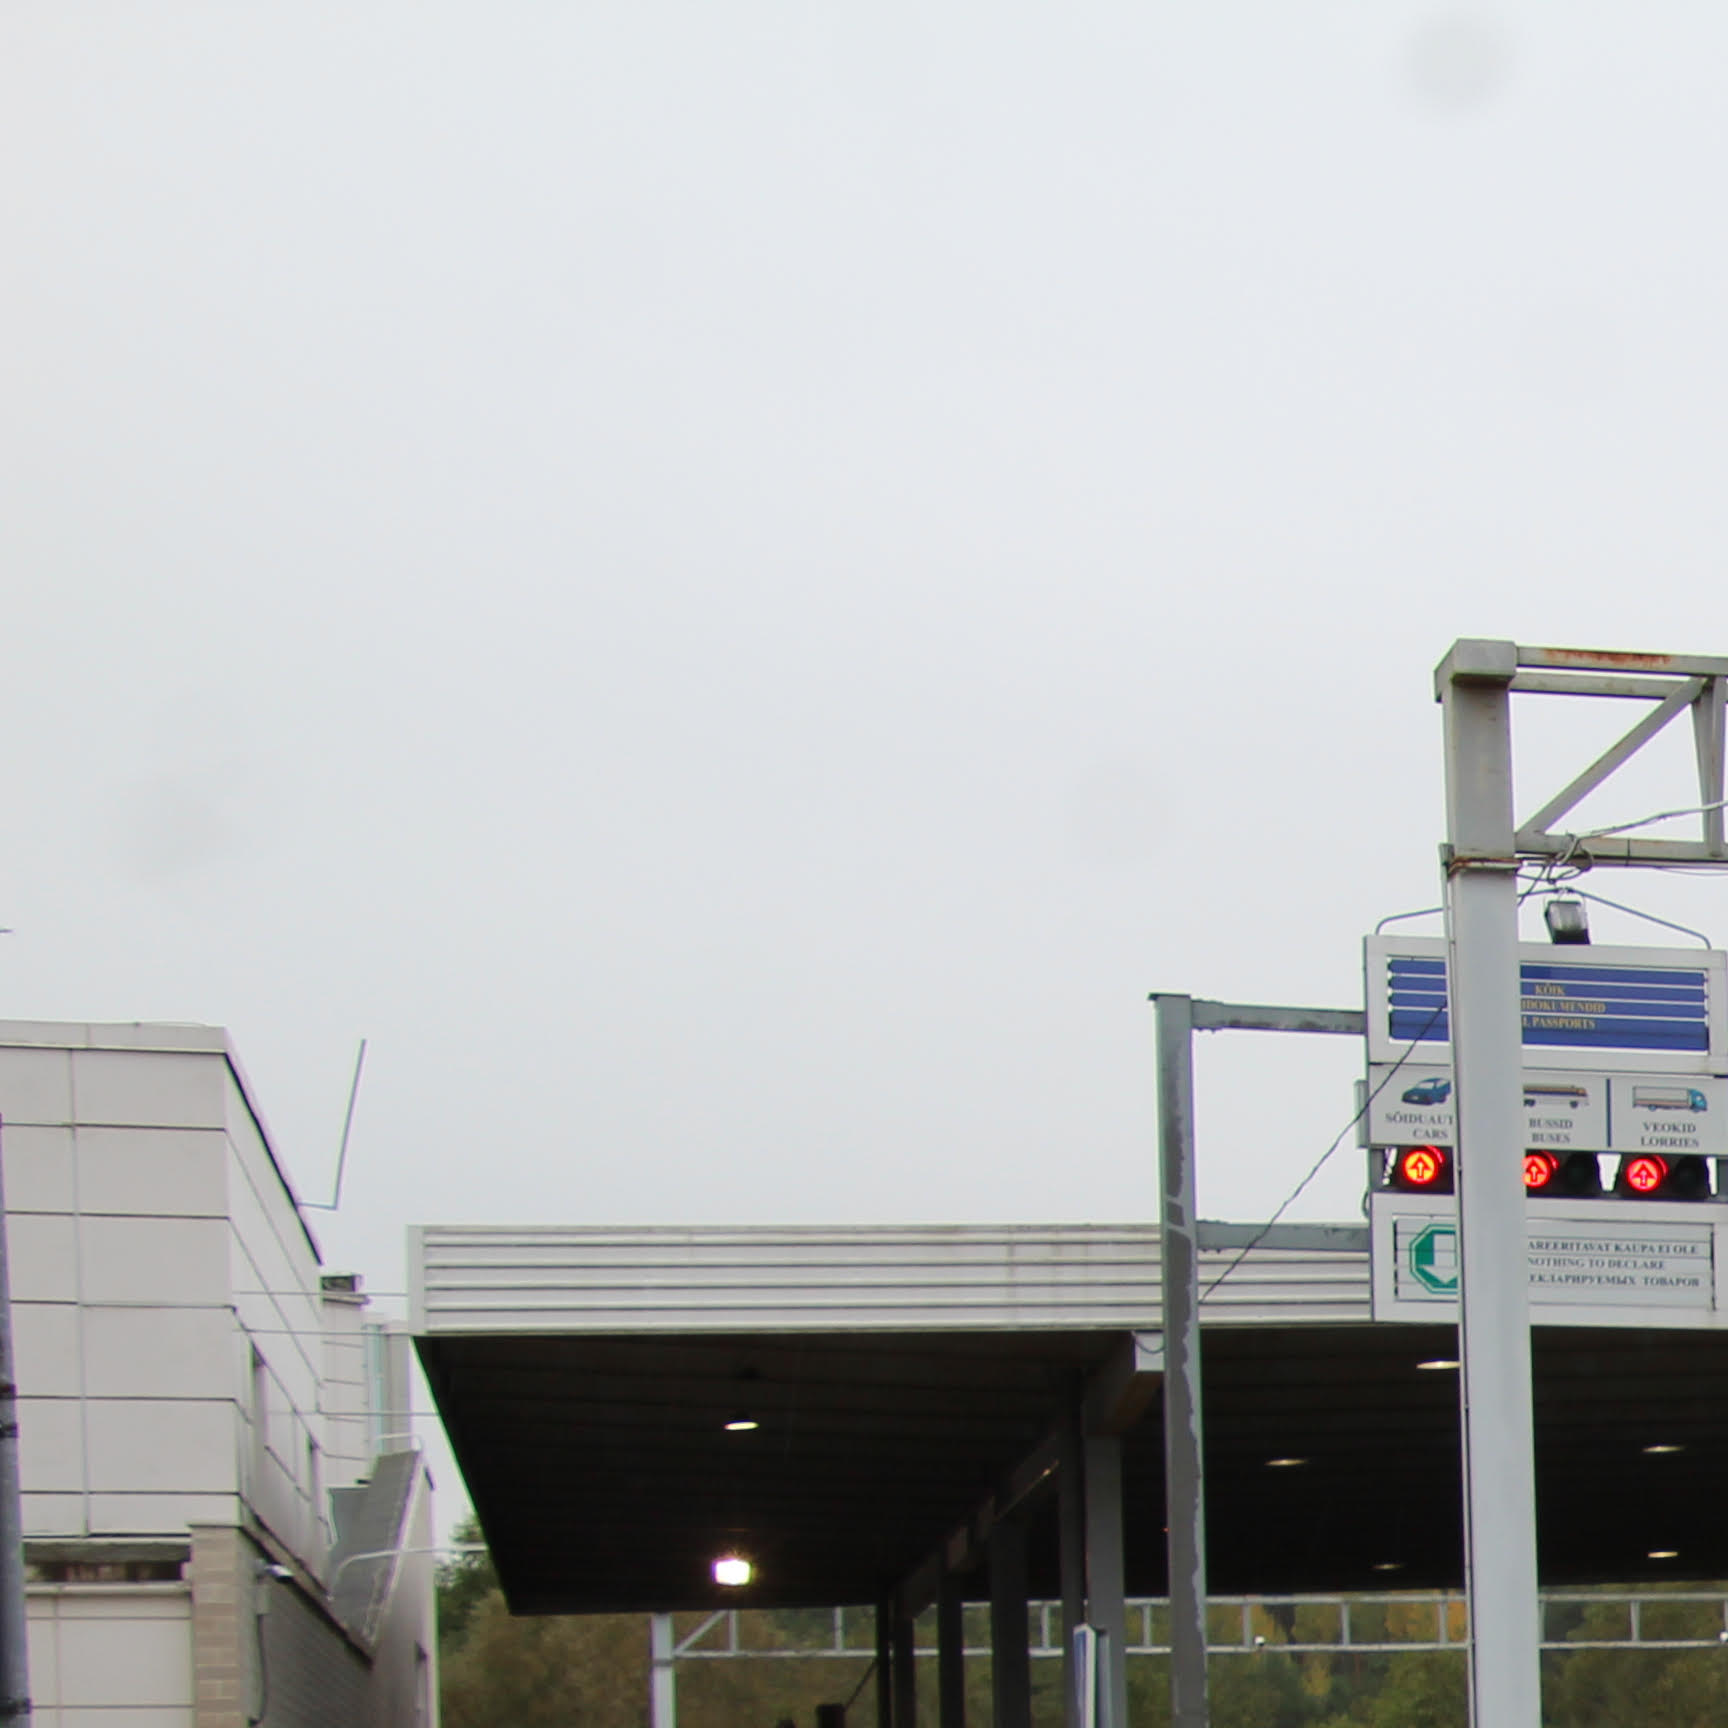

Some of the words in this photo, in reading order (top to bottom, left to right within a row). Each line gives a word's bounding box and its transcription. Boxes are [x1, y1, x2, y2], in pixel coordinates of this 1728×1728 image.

[1535, 983, 1565, 997] KÕIK
[1522, 998, 1606, 1014] IDOKUMENDID
[1532, 1017, 1596, 1030] PASSPORTS
[1386, 1110, 1454, 1126] SÕIDUAUT
[1529, 1118, 1573, 1130] BUSSID
[1412, 1128, 1448, 1140] CARS
[1643, 1121, 1696, 1134] VEOKID
[1532, 1132, 1571, 1144] BUSES
[1640, 1136, 1700, 1149] LORRIES
[1528, 1241, 1611, 1252] AREERITAVAT
[1615, 1243, 1655, 1253] KAUPA
[1673, 1245, 1697, 1255] OLE
[1589, 1259, 1605, 1269] TO
[1608, 1259, 1665, 1270] DECLARE
[1529, 1273, 1636, 1286] ЕКЛАРИРУЕМЫХ
